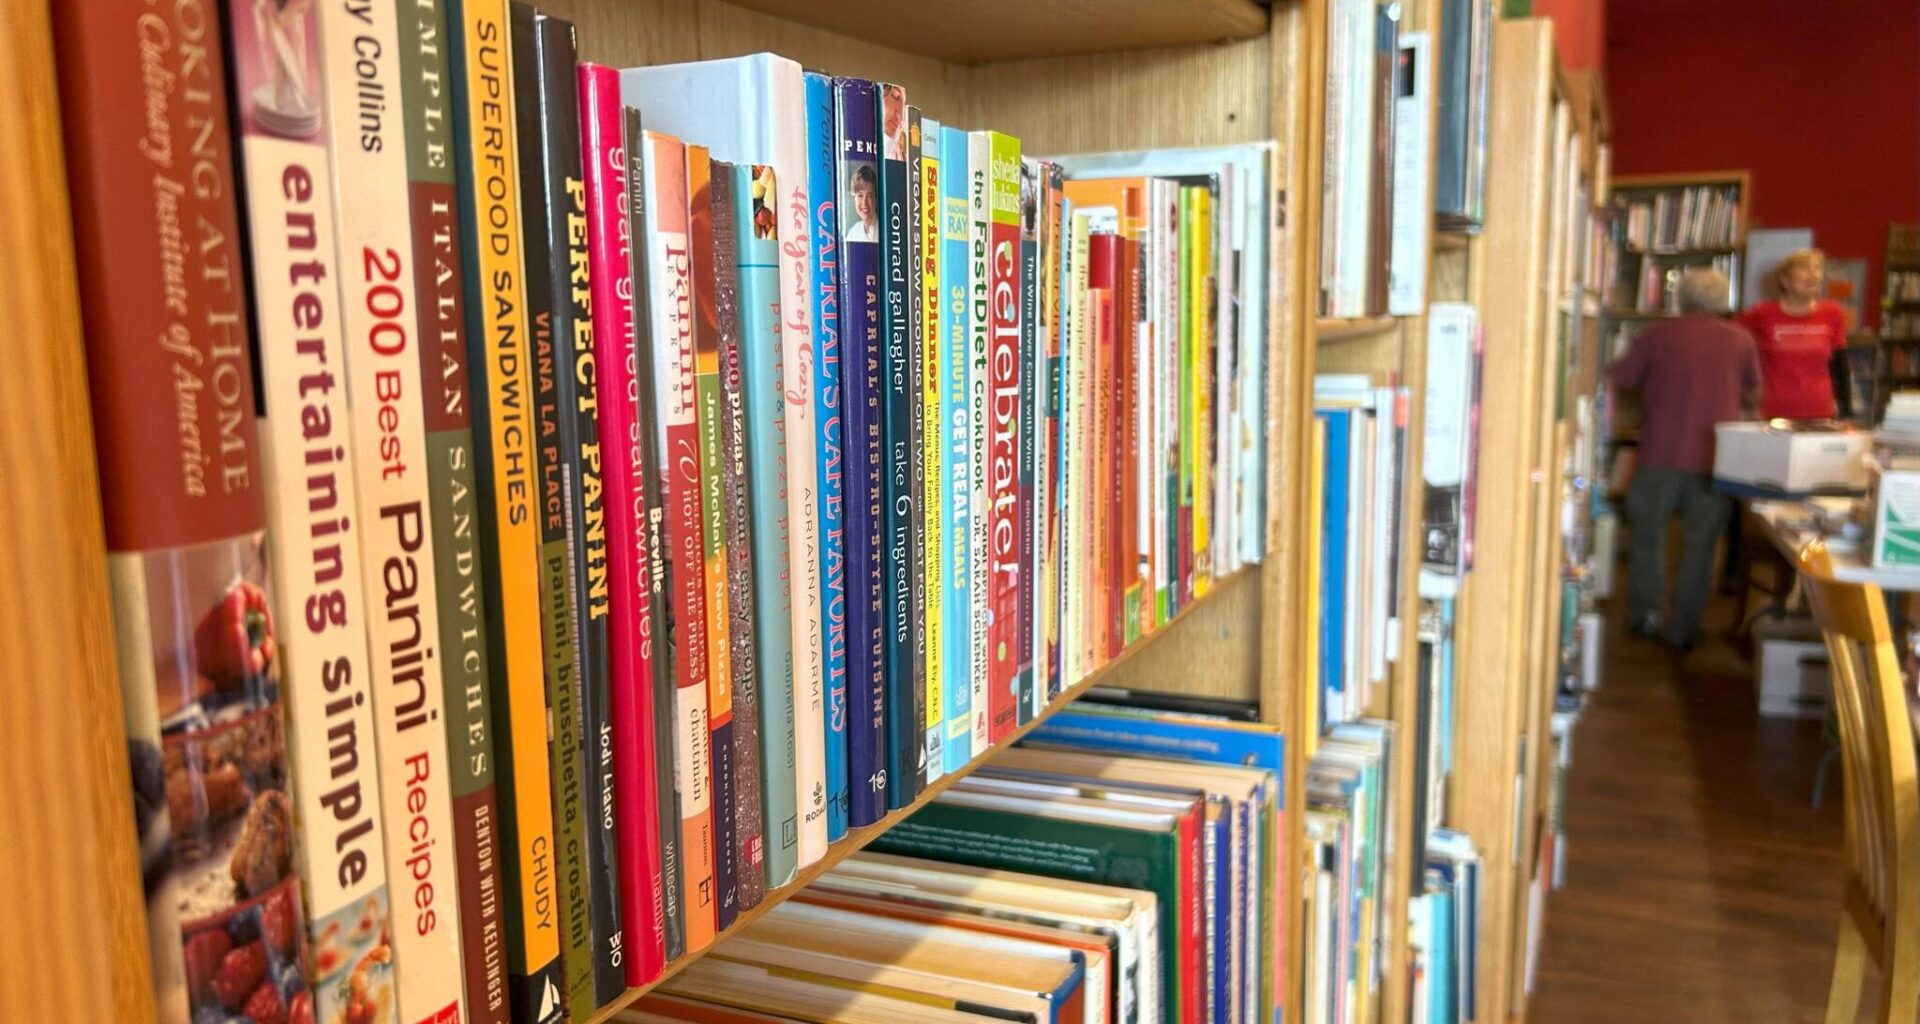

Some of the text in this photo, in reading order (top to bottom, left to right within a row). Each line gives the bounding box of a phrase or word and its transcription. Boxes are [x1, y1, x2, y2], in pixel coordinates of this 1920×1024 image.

[354, 36, 385, 153] Collins
[632, 157, 644, 215] Panini
[790, 185, 807, 230] the
[913, 157, 921, 226] VEGAN
[947, 215, 968, 234] RAY
[138, 13, 207, 498] Culinary Institute of America
[198, 218, 231, 293] AT
[476, 18, 527, 526] SUPERFOOD SANDWICHES
[817, 201, 841, 408] CAPRIAL'S
[913, 231, 922, 290] SLOW
[925, 166, 939, 393] Saving Dinner
[432, 200, 464, 418] ITALIAN
[666, 243, 694, 416] Panini
[666, 264, 682, 415] EXPRESS
[770, 303, 785, 391] pasta
[786, 308, 810, 335] of
[914, 296, 923, 386] COOKING
[974, 169, 988, 490] the FastDiet Cookbook
[209, 311, 249, 493] HOME
[565, 176, 610, 621] PERFECT PANINI
[608, 147, 630, 257] great
[629, 421, 653, 661] sandwiches
[727, 343, 740, 386] 100
[775, 400, 785, 413] &
[786, 342, 813, 420] Cozy
[915, 393, 923, 431] FOR
[535, 312, 561, 530] VIANA LA PLACE
[678, 437, 700, 484] 70
[728, 390, 745, 476] pizzas
[774, 419, 789, 499] pizza
[888, 203, 912, 643] conrad gallagher take 6 ingredients
[916, 437, 924, 482] TWO
[952, 285, 969, 590] 30-MINUTE GET REAL MEALS
[1026, 404, 1034, 435] with
[281, 163, 374, 890] entertaining simple
[649, 507, 664, 593] Breville
[692, 487, 705, 590] DELICIOUS
[706, 392, 727, 697] James McNair's New Pizza
[866, 274, 884, 729] CAPRIAL'S BISTRO-STYLE CUISINE
[917, 525, 925, 571] JUST
[363, 246, 438, 937] 200 Best Panini Recipes
[447, 446, 489, 778] SANDWICHES
[547, 557, 571, 660] panini,
[683, 490, 699, 678] HOT OFF THE PRESS
[738, 569, 752, 625] easy
[803, 487, 822, 712] ADRIANNA ADARME
[974, 546, 982, 604] SARAH
[741, 631, 756, 704] recipe
[827, 527, 847, 732] FAVORITES
[974, 609, 982, 694] SCHENKER
[556, 664, 576, 834] bruschetta,
[600, 721, 615, 830] Jodi Liano
[690, 708, 703, 802] chattman
[723, 744, 733, 875] CHRONICLE BOOKS
[474, 804, 502, 1012] DENTON WITH KELLINGER
[530, 836, 552, 931] CHUDY
[564, 836, 588, 951] crostini
